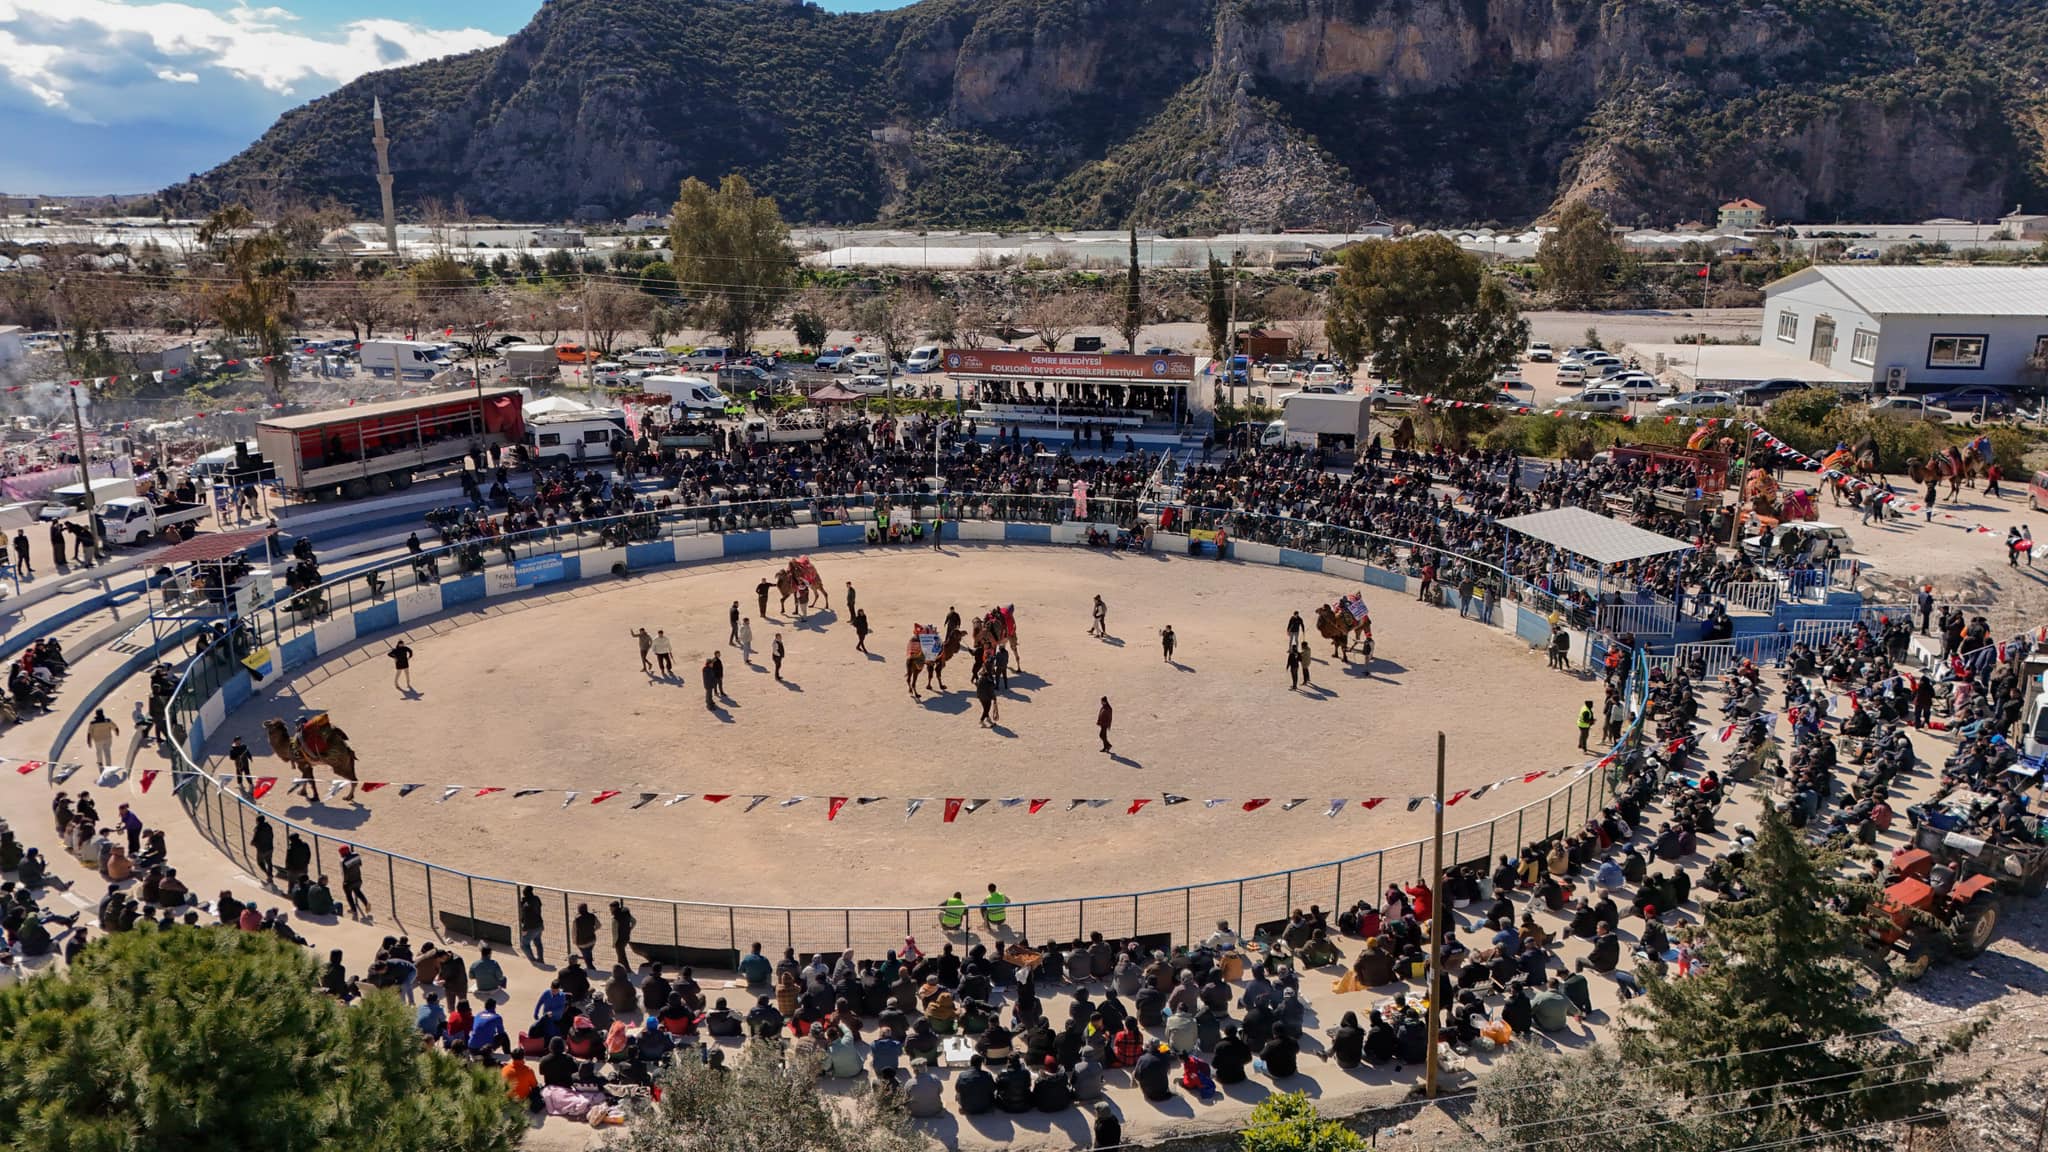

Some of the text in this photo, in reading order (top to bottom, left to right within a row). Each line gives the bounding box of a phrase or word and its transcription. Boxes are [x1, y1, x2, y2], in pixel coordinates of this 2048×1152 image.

[1031, 355, 1102, 366] DEMRE BELEDİYESİ
[991, 364, 1143, 377] FOLKLORİK DEVE GÖSTERİLERİ FESTİVALİ
